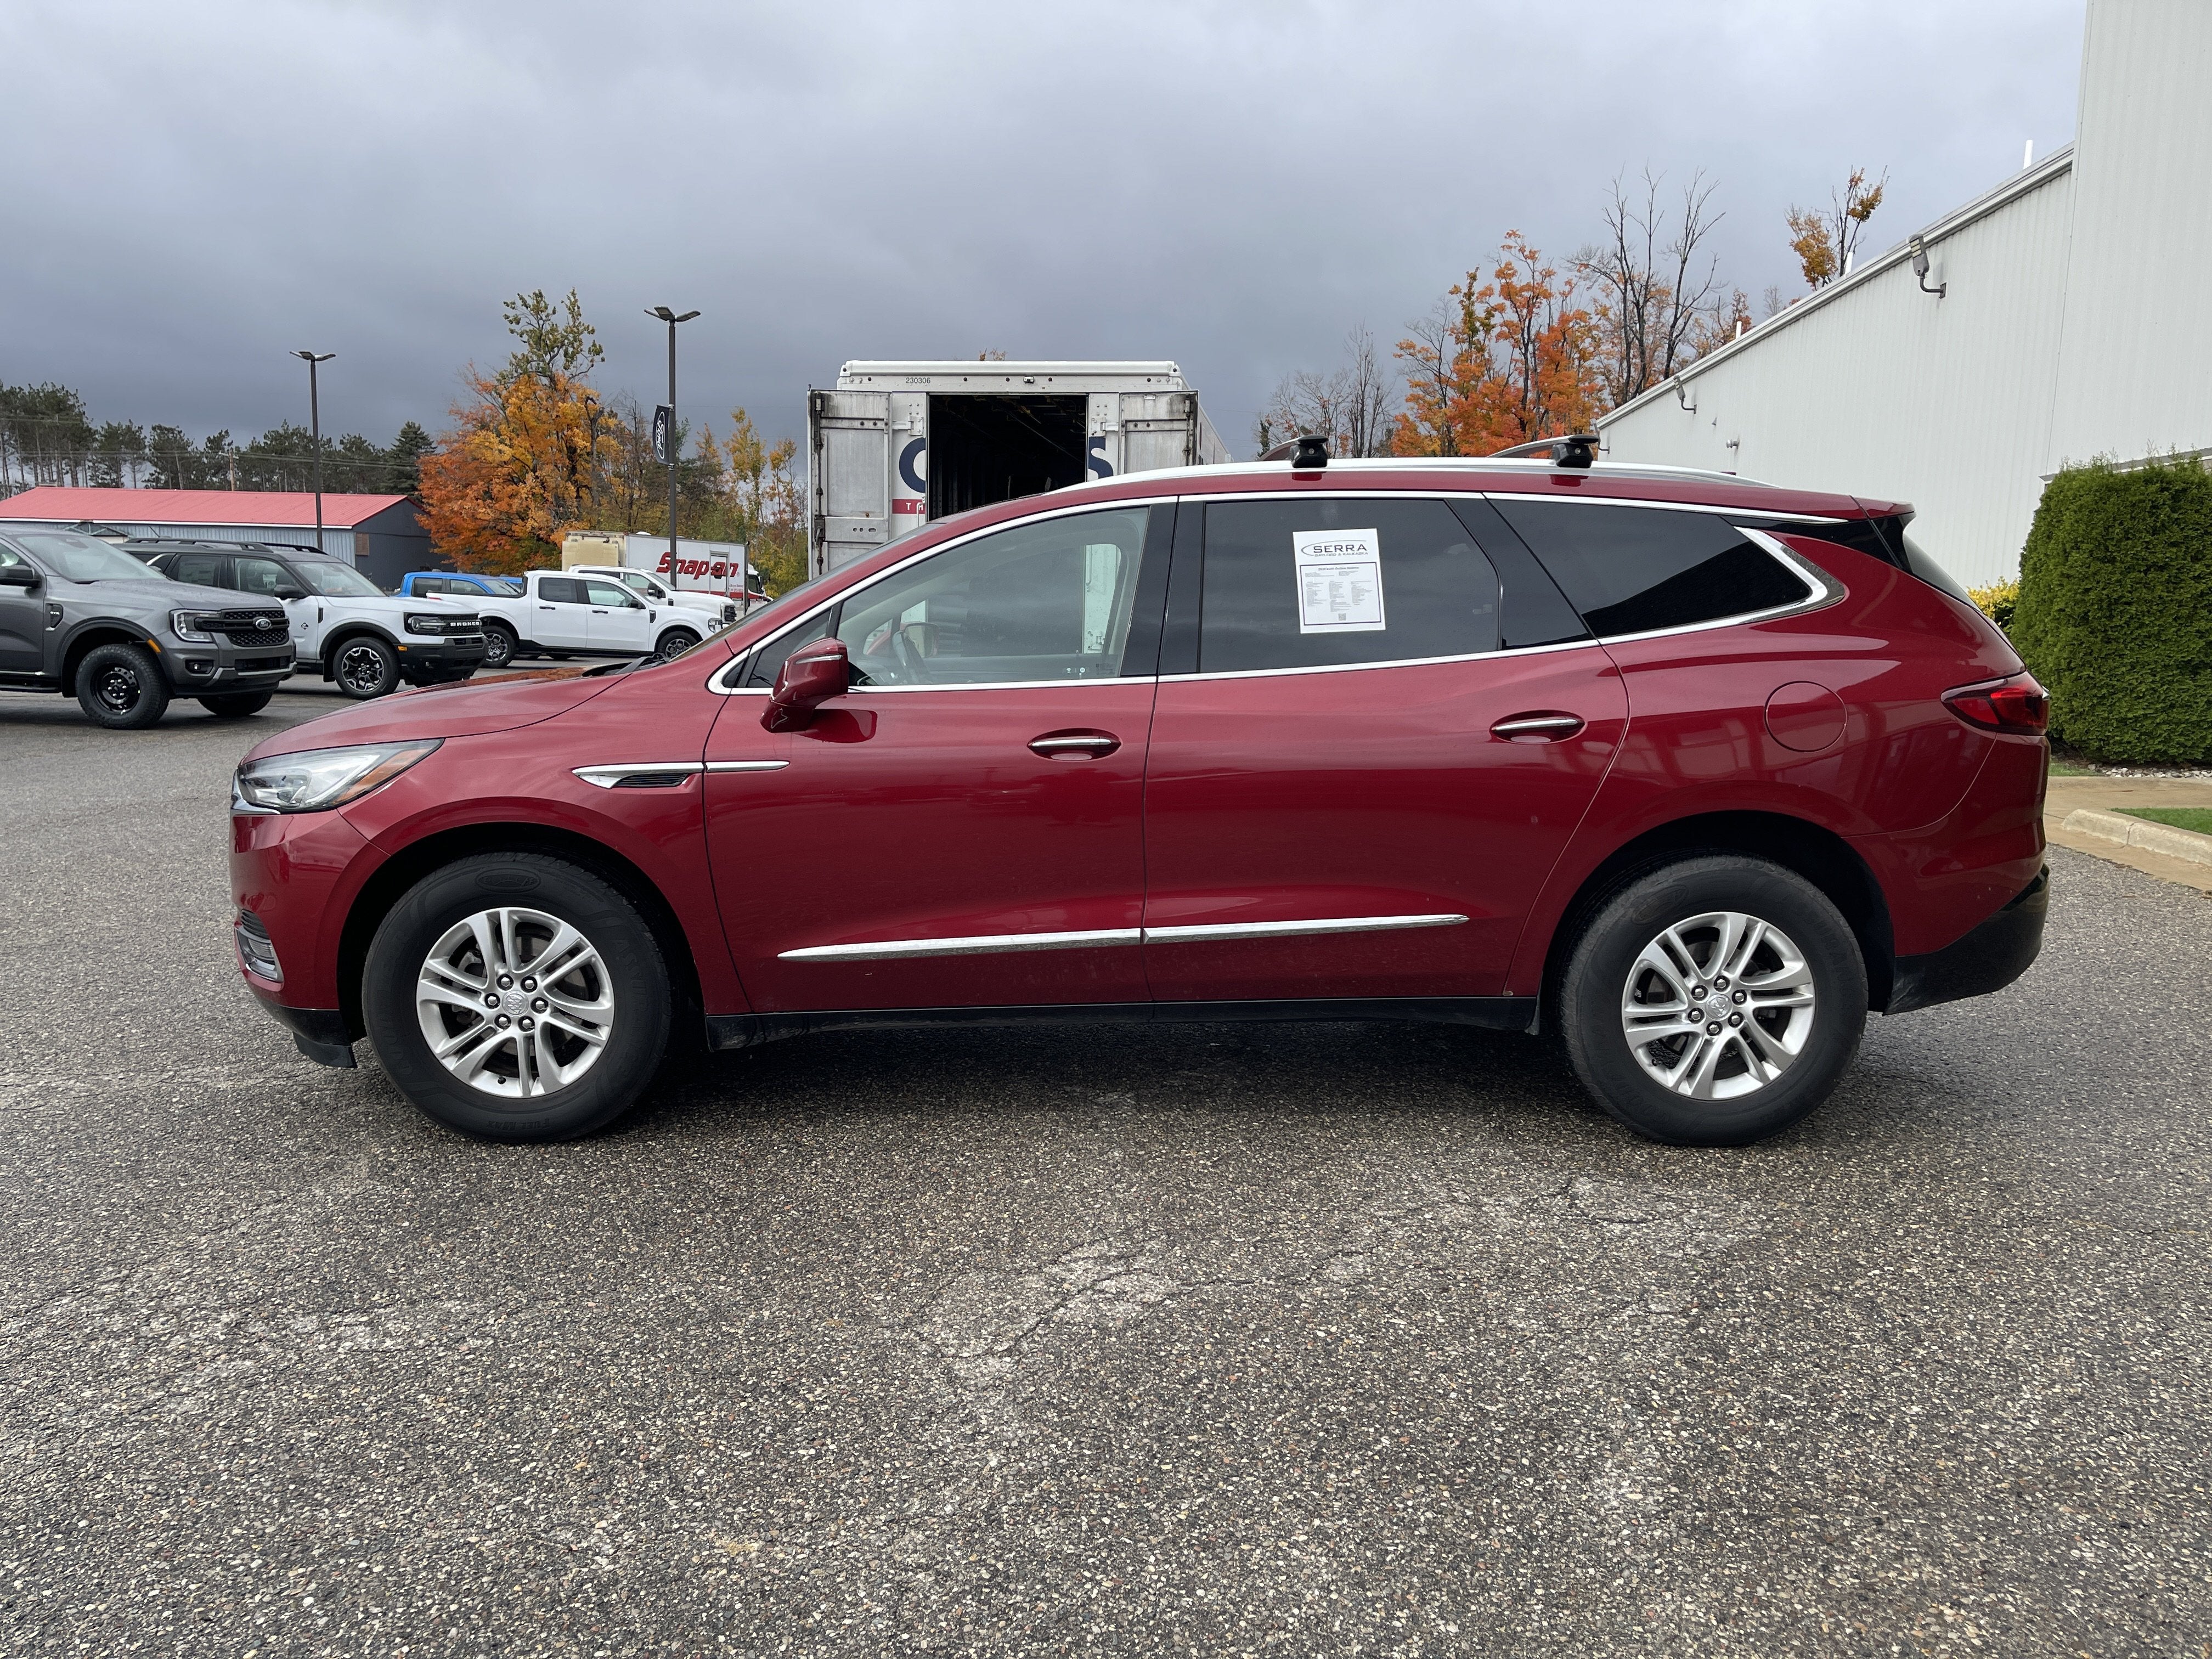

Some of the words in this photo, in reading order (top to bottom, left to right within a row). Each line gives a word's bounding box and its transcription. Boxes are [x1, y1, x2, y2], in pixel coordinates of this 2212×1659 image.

[1313, 544, 1368, 553] SERRA
[656, 551, 739, 580] Snap-on
[520, 1118, 551, 1131] FUEL
